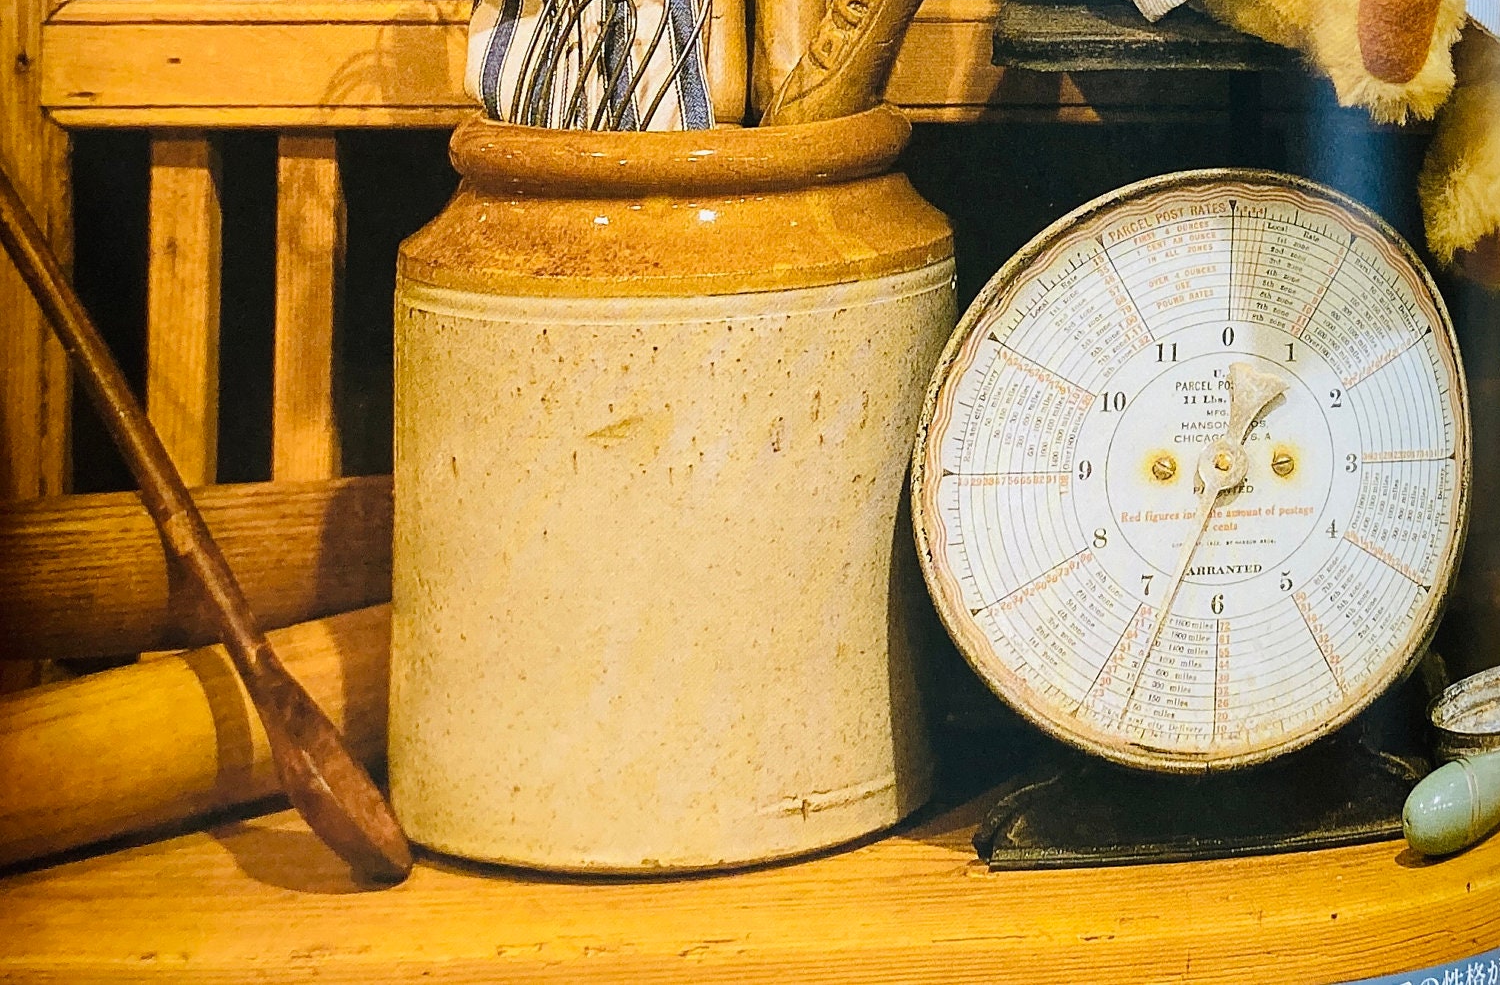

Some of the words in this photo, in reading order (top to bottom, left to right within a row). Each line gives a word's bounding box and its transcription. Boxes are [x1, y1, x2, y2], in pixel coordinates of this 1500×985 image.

[1109, 216, 1152, 242] PARCEL
[1156, 207, 1184, 224] POST
[1190, 203, 1226, 216] RATES
[1133, 232, 1155, 246] FIRST
[1177, 221, 1209, 232] OUNCES
[1146, 241, 1167, 251] CENT
[1189, 232, 1216, 241] OUNCE
[1188, 244, 1213, 253] ZONES
[1148, 276, 1169, 288] OVER
[1184, 265, 1217, 276] OUNCES
[1176, 280, 1191, 290] USE
[1156, 296, 1184, 309] POUND
[1189, 289, 1214, 300] RATES
[1221, 326, 1235, 346] 0
[1156, 343, 1179, 362] 11
[1286, 343, 1296, 362] 1
[981, 371, 998, 401] Delivery
[1176, 381, 1212, 391] PARCEL
[1101, 392, 1126, 411] 10
[1184, 396, 1197, 404] 11
[1330, 390, 1343, 409] 2
[1078, 460, 1091, 480] 9
[1346, 454, 1358, 473] 3
[1121, 512, 1141, 522] Red
[1145, 510, 1179, 522] figures
[1226, 509, 1262, 517] amount
[1266, 505, 1275, 515] of
[1326, 519, 1338, 538] 4
[1093, 529, 1107, 549] 8
[1186, 564, 1262, 576] ARRANTED
[1141, 574, 1154, 595] 7
[1280, 569, 1293, 591] 5
[1211, 594, 1224, 614] 6
[1192, 620, 1213, 629] miles
[1189, 633, 1210, 641] miles
[1188, 646, 1208, 654] miles
[1181, 660, 1202, 668] miles
[1175, 673, 1197, 681] miles
[1170, 685, 1191, 693] miles
[1166, 699, 1188, 707] miles
[1154, 710, 1175, 718] miles
